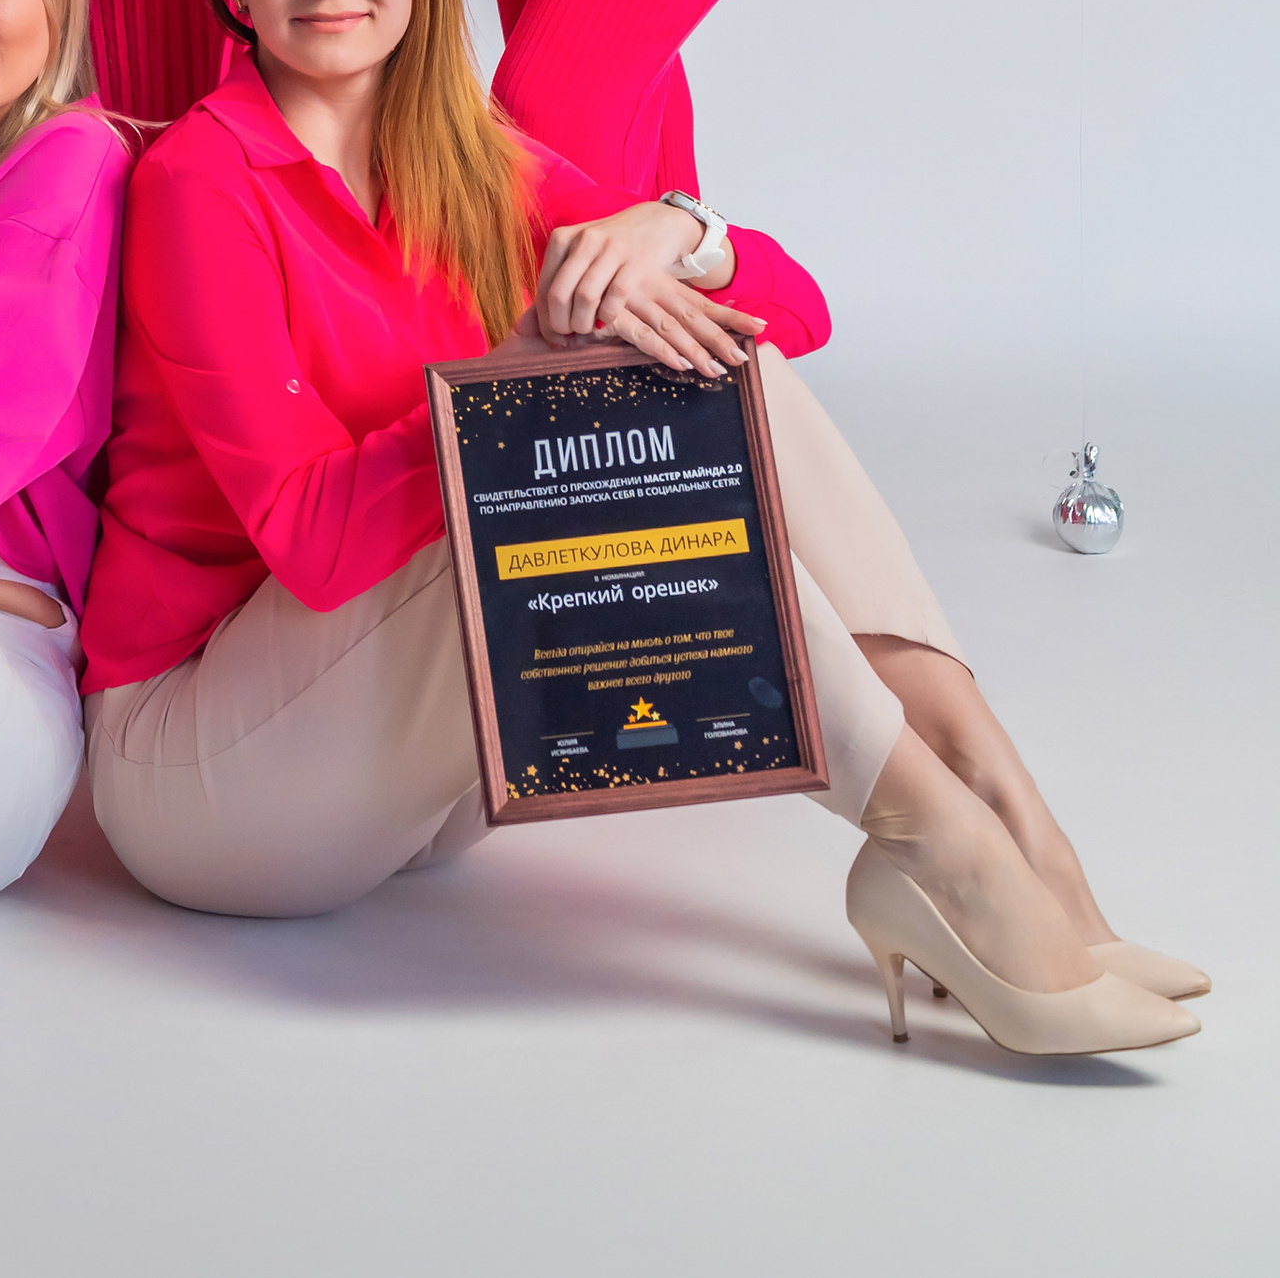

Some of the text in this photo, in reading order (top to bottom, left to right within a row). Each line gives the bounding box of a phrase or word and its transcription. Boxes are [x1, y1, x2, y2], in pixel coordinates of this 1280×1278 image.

[534, 425, 675, 479] ДИПЛОМ
[473, 463, 742, 502] СВИДЕТЕЛЬСТВУЕТ О ПРОХОЖДЕНИИ МАСТЕР МАЙНДА 2.0
[479, 477, 740, 514] ПО НАПРАВЛЕНИЮ ЗАПУСКА СЕБЯ В СОЦИАЛЬНЫХ СЕТЯХ
[508, 530, 736, 573] ДАВЛЕТКУЛОВА ДИНАРА
[527, 578, 718, 613] «Крепкий орешек»
